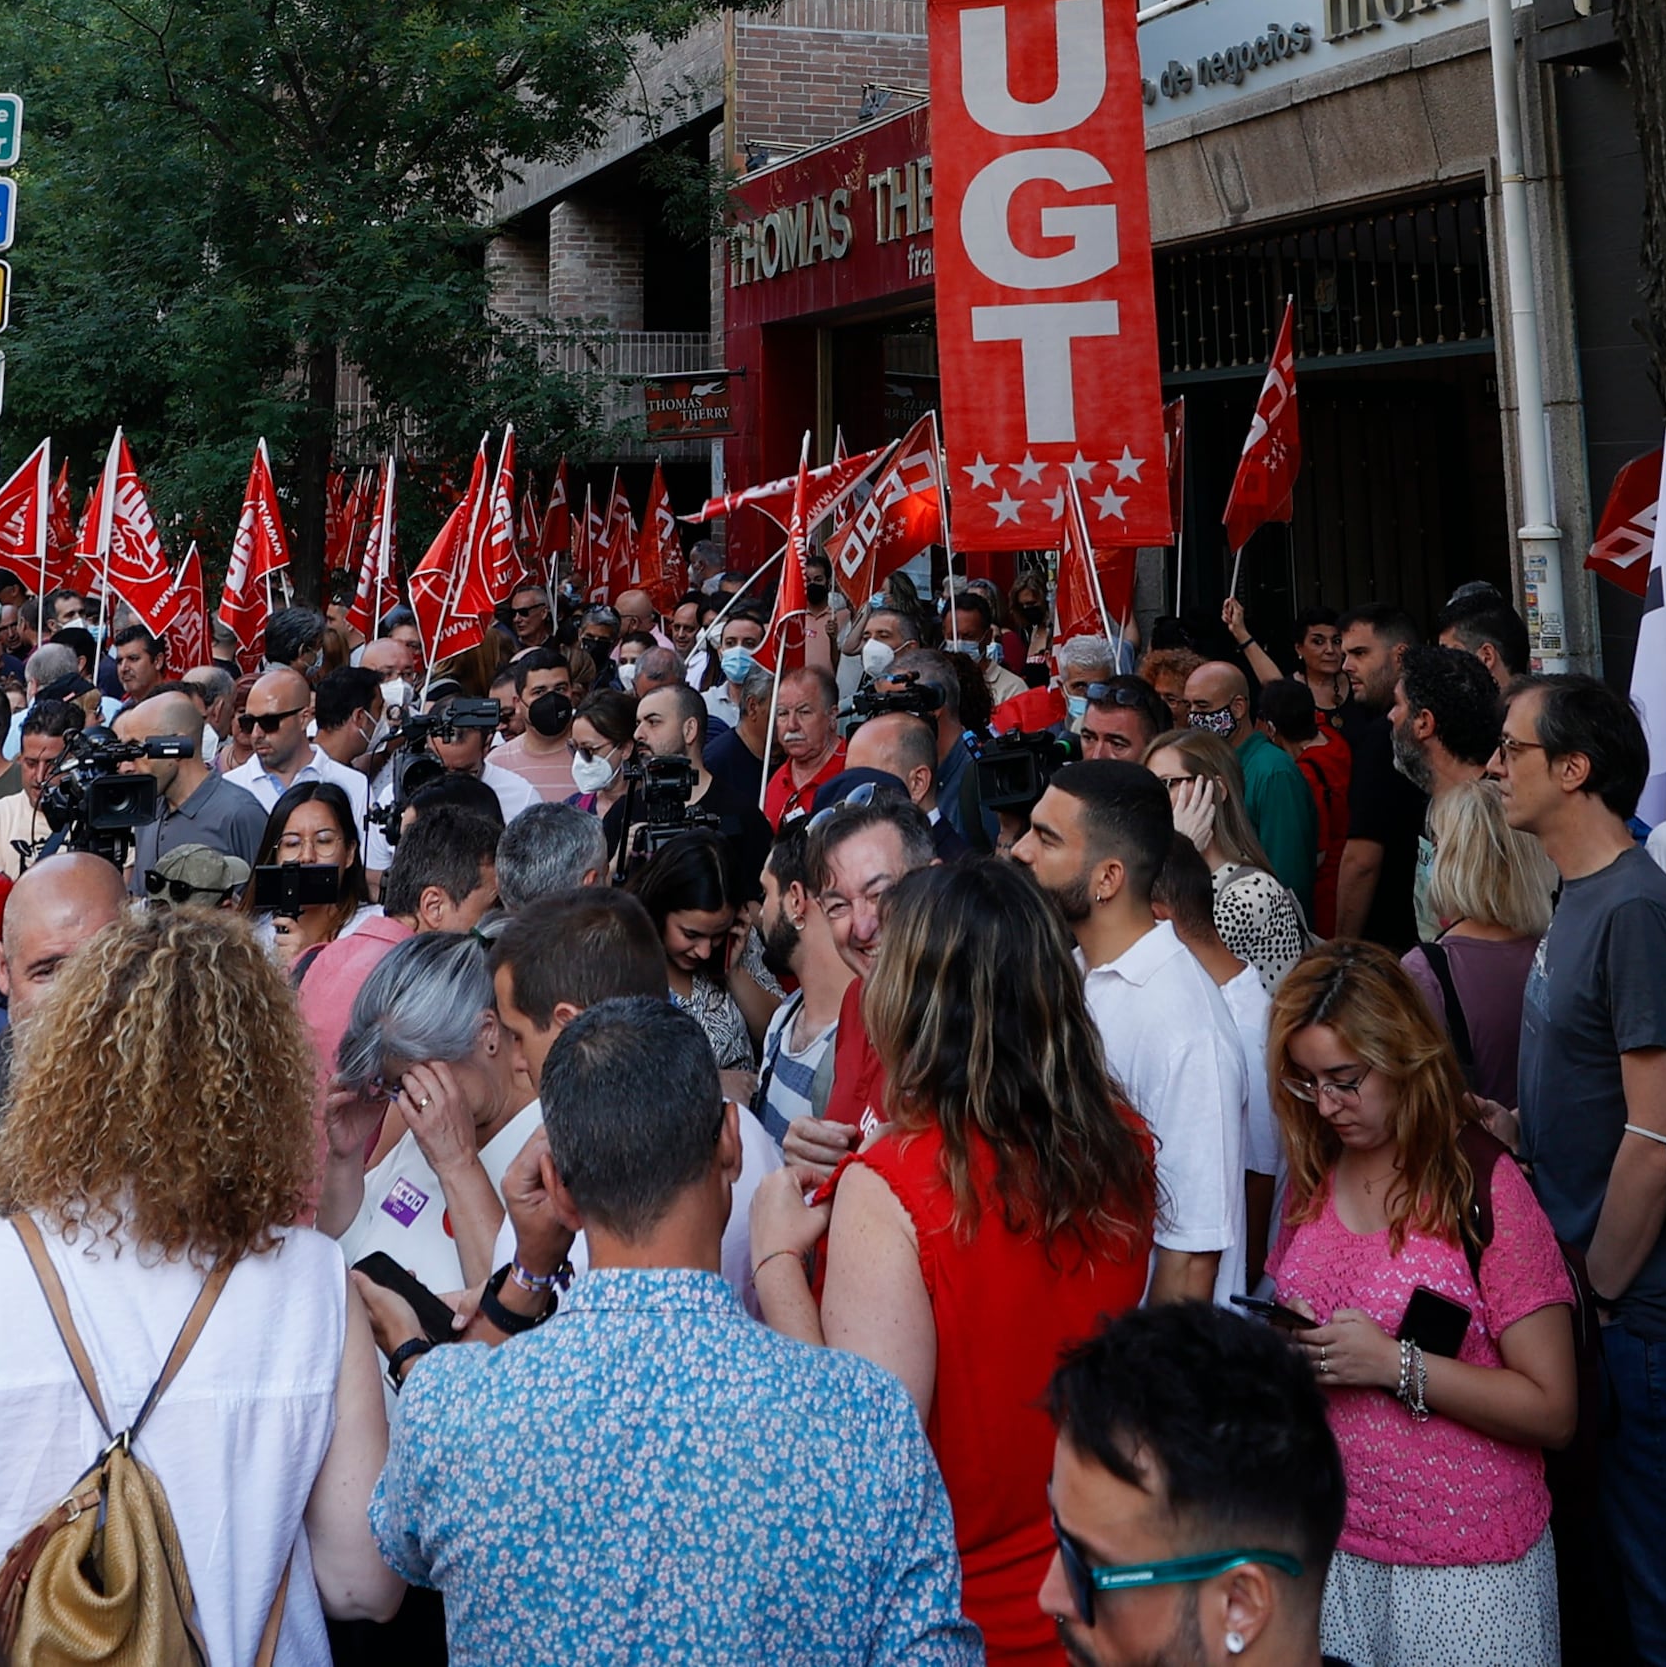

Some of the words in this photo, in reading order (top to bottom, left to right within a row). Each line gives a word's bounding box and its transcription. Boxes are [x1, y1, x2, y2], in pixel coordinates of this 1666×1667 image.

[1161, 60, 1193, 98] de
[1197, 21, 1313, 86] negocios
[731, 188, 853, 288] THOMAS
[907, 243, 937, 280] fra
[647, 397, 702, 411] THOMAS
[679, 407, 730, 421] THERRY
